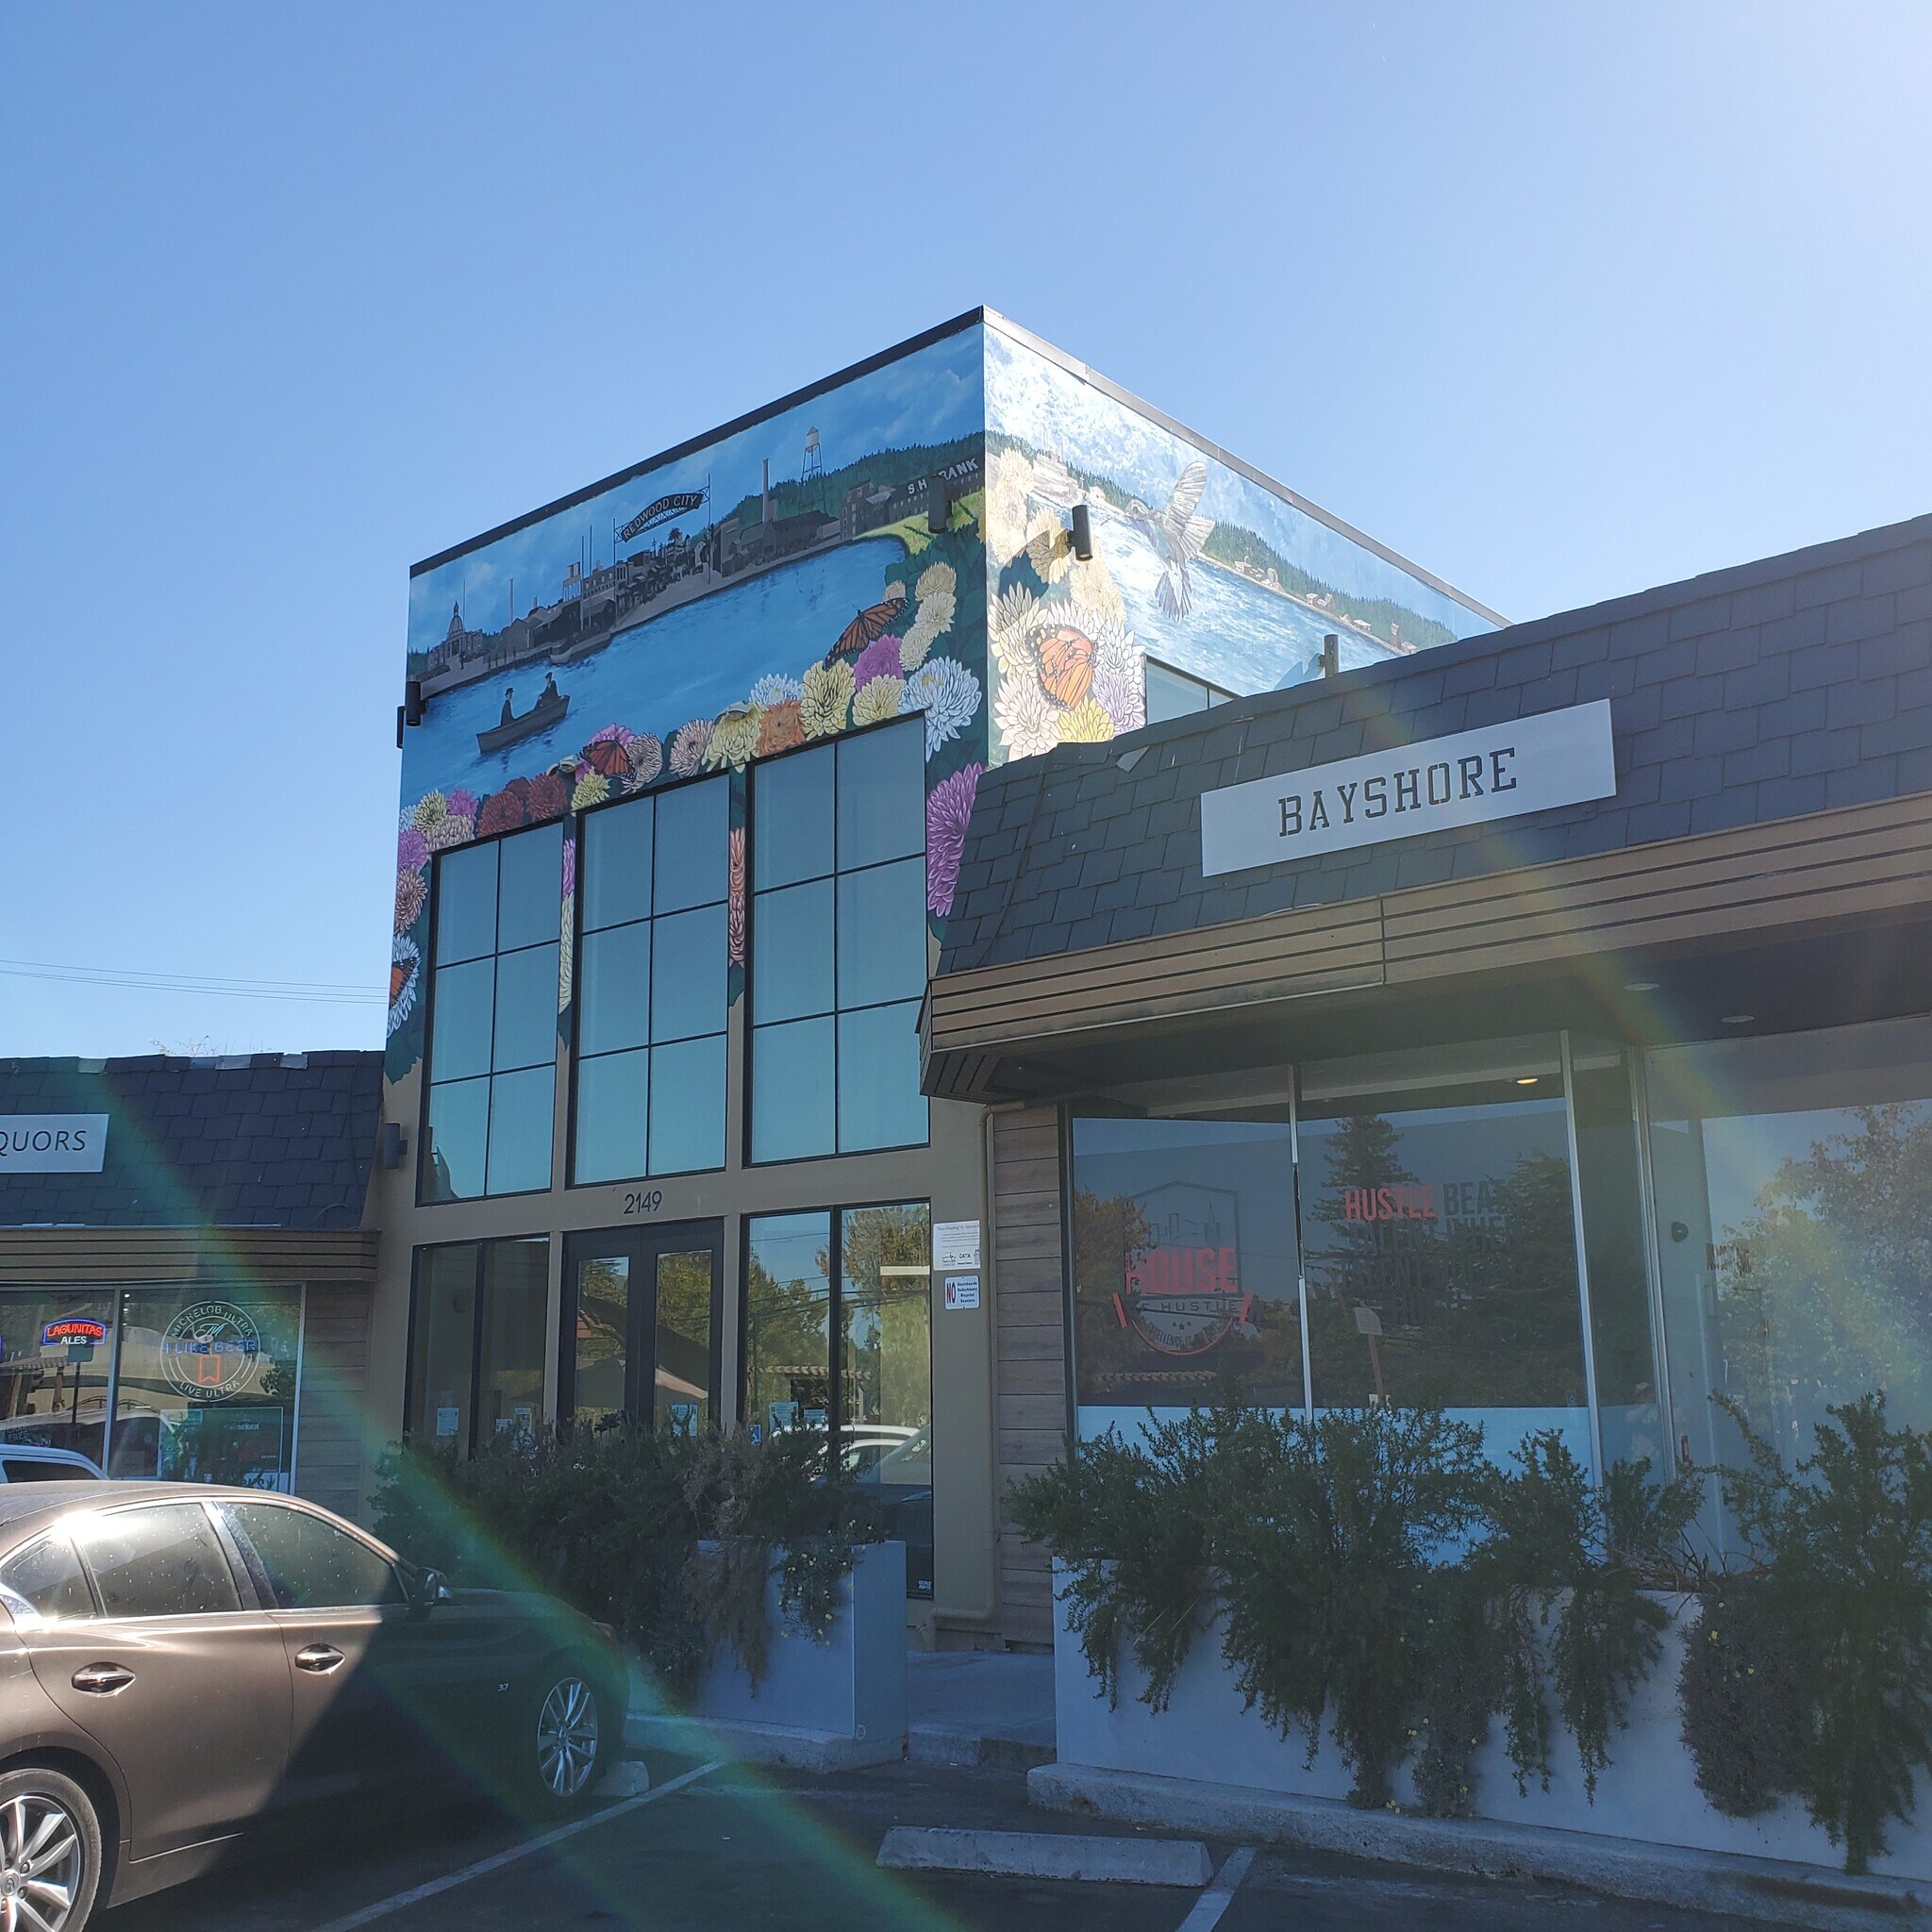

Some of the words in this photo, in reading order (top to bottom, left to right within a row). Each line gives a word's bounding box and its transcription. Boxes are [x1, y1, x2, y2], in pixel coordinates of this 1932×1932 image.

[623, 498, 670, 540] REDWOOD
[674, 495, 697, 507] CITY
[1277, 747, 1517, 838] BAYSHORE
[624, 1190, 662, 1214] 2149
[1344, 1184, 1437, 1222] HUSTLE
[1125, 1246, 1239, 1294] HOUSE
[946, 1282, 957, 1304] NO
[1160, 1300, 1239, 1312] HUSTLE
[46, 1323, 103, 1337] LAGUNITAS
[171, 1306, 223, 1339] MICHELOB
[224, 1311, 253, 1337] ULTRA
[60, 1336, 87, 1344] ALES
[165, 1342, 170, 1354] I
[175, 1341, 208, 1354] LIKE
[214, 1340, 256, 1353] BEER
[179, 1381, 202, 1397] LIVE
[206, 1380, 240, 1398] ULTRA
